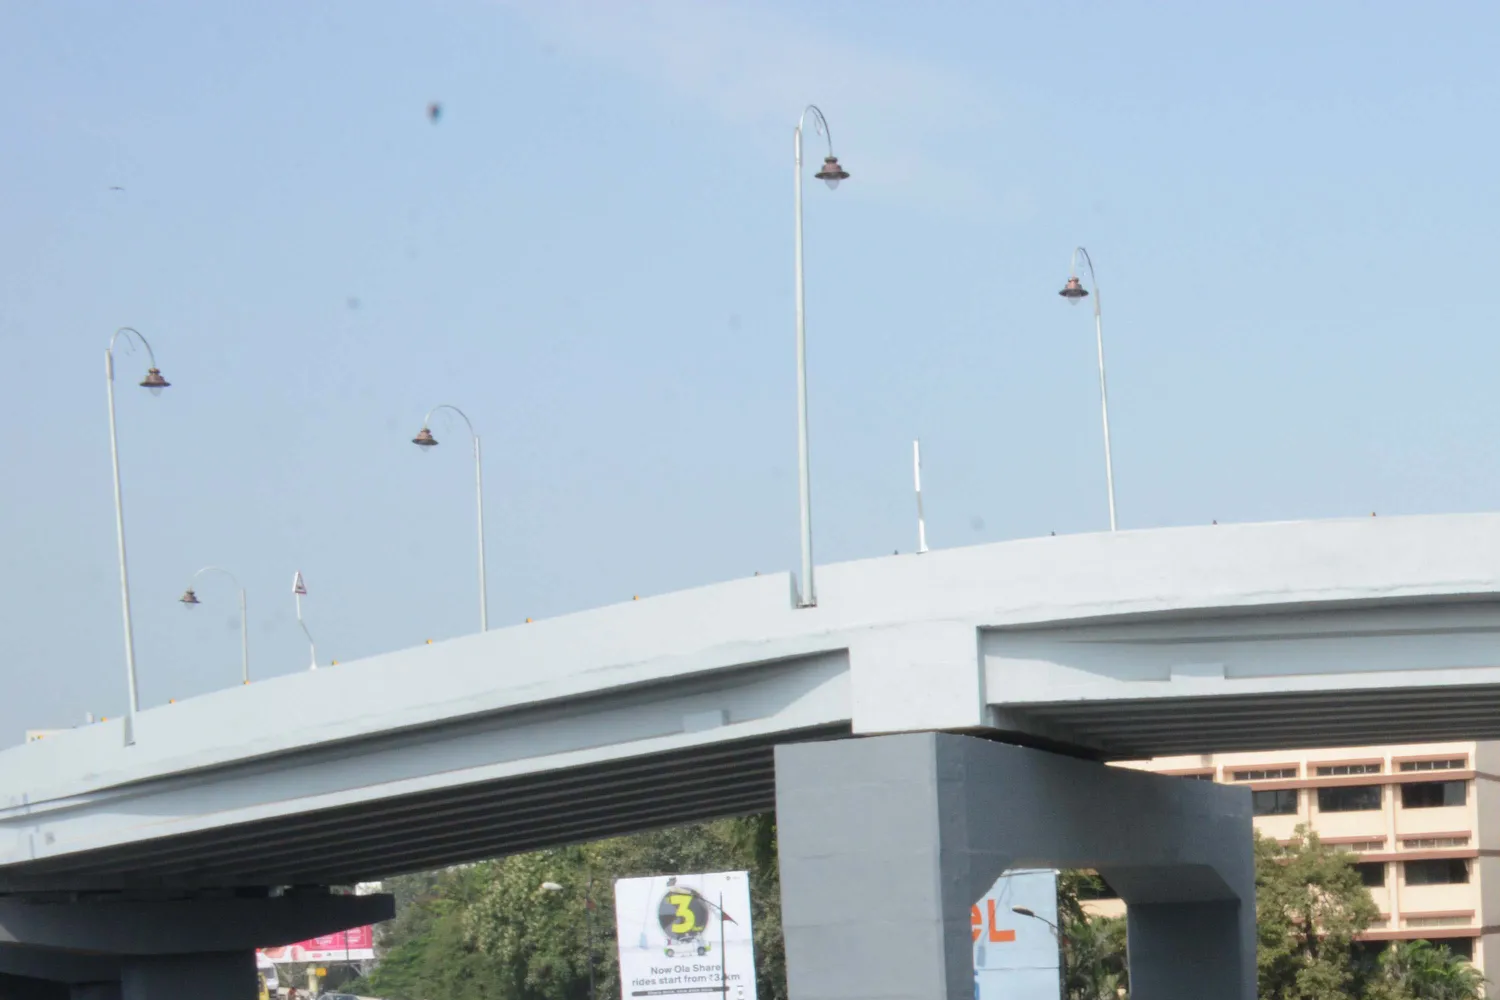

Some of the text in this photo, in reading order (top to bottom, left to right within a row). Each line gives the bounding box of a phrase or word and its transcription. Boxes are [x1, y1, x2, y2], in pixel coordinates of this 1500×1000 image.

[670, 894, 695, 933] 3
[651, 964, 721, 975] Now Ola Share
[632, 978, 656, 986] rides
[659, 976, 681, 984] start
[684, 975, 707, 983] from
